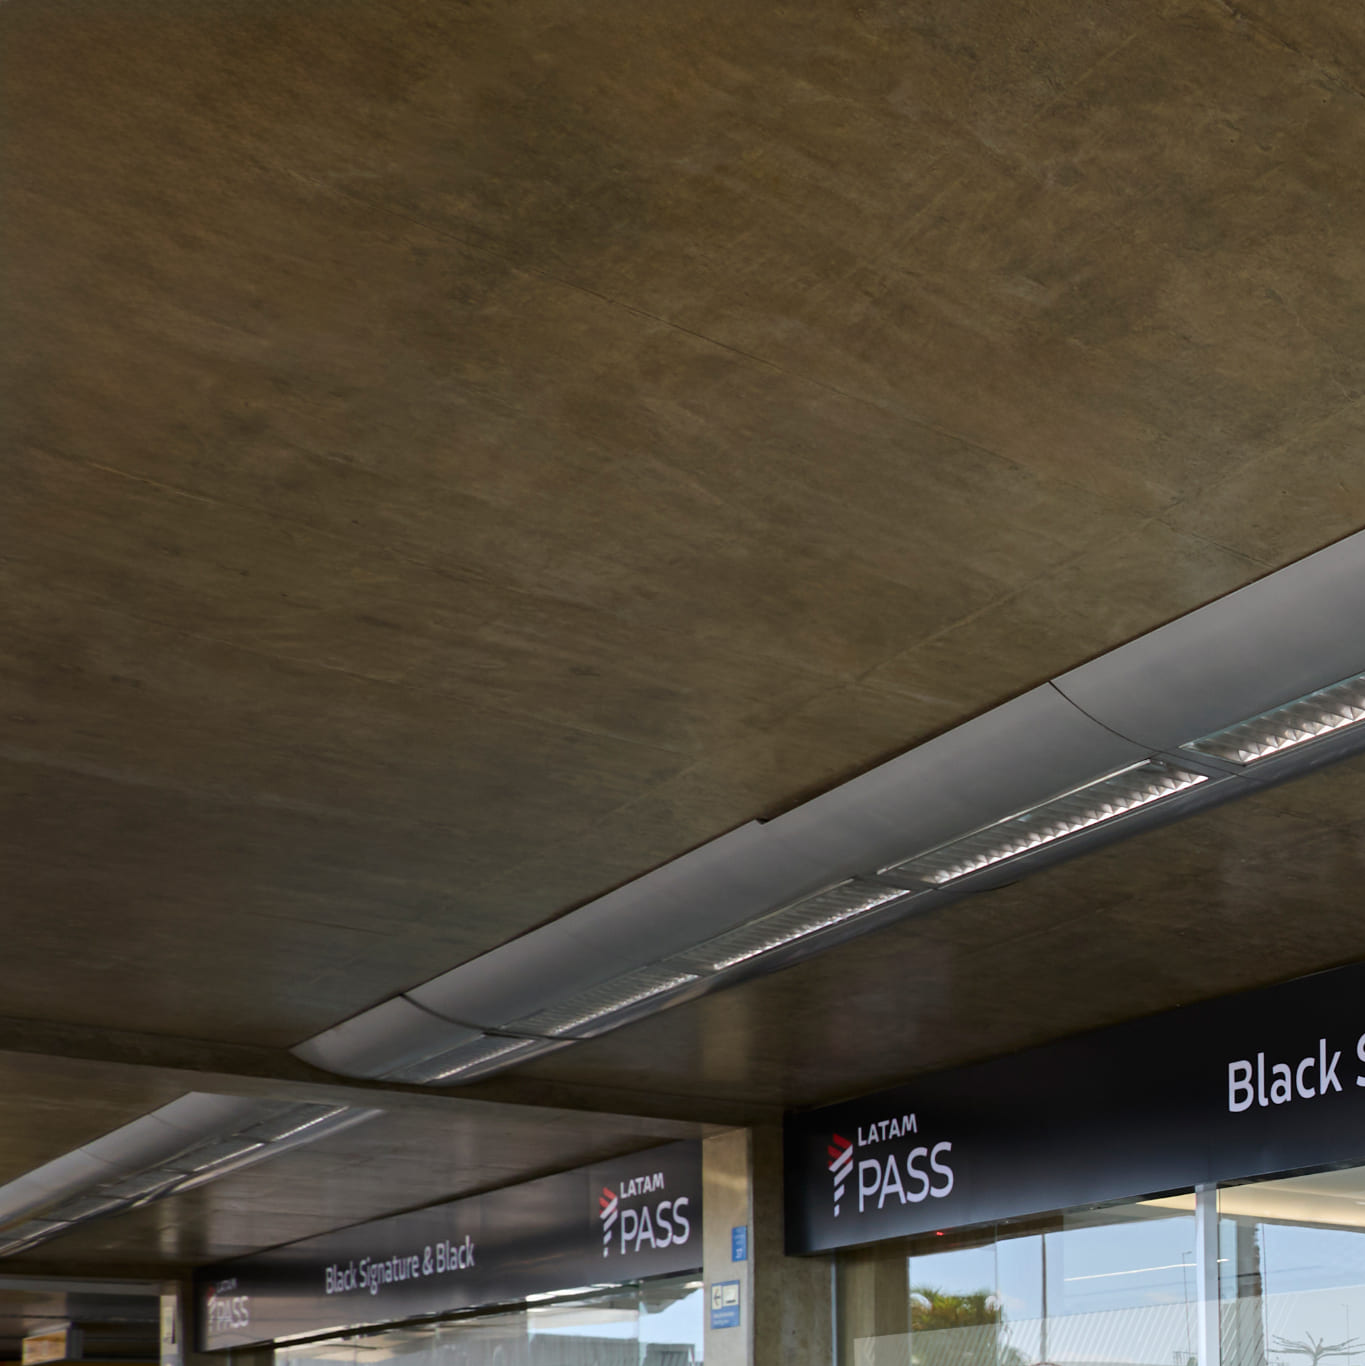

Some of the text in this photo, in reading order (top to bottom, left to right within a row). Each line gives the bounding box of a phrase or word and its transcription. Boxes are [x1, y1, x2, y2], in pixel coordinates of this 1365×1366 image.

[1228, 1037, 1343, 1113] Black
[858, 1114, 918, 1146] LATAM
[620, 1172, 665, 1199] LATAM
[858, 1141, 954, 1213] PASS
[620, 1196, 690, 1255] PASS
[325, 1234, 475, 1296] Black Signature & Black
[216, 1295, 249, 1331] PASS
